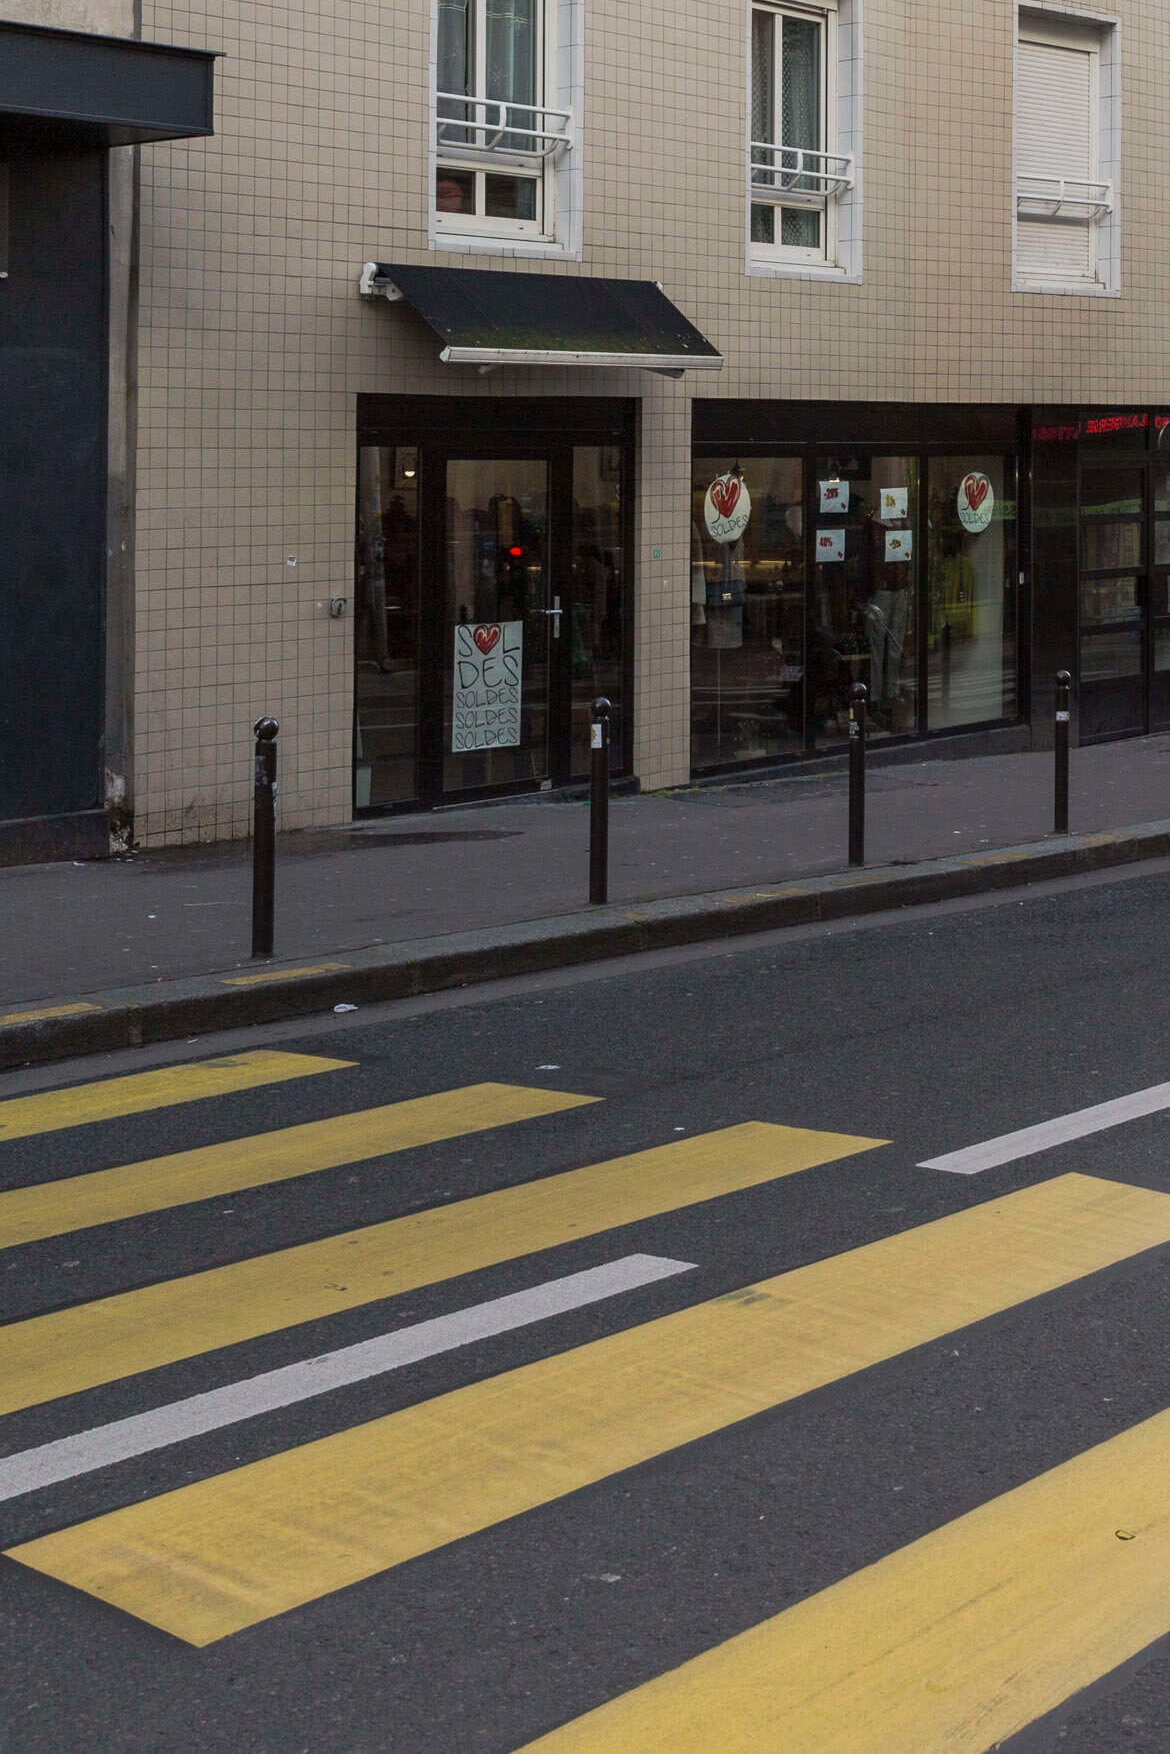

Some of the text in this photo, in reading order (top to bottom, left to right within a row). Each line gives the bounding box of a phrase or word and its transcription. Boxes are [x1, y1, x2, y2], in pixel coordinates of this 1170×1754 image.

[710, 515, 749, 536] SOLDES
[457, 655, 519, 689] DES
[456, 688, 518, 708] SOLDES
[455, 708, 518, 729] SOLDES
[455, 728, 517, 749] SOLDES
